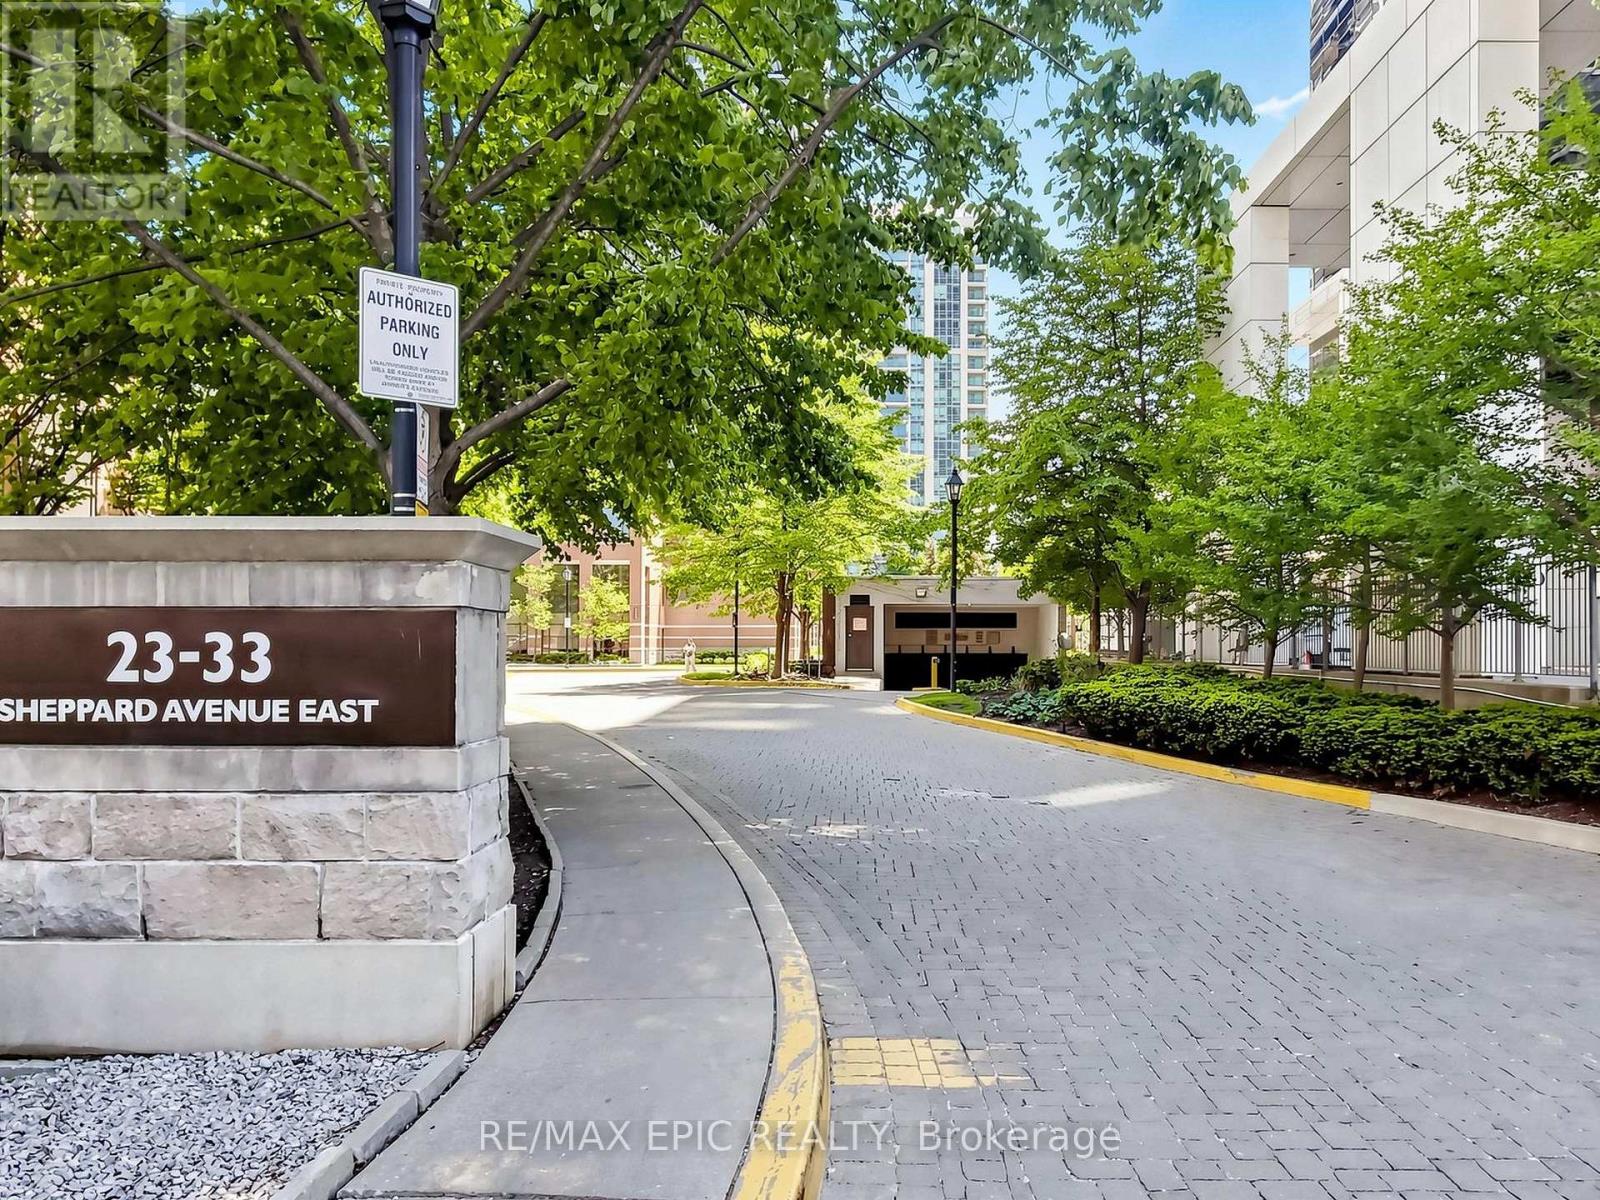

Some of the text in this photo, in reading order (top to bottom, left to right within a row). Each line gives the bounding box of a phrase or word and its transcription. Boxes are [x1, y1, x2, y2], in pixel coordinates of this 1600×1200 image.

[367, 290, 452, 318] AUTHORIZED
[380, 316, 440, 339] PARKING
[393, 342, 428, 360] ONLY
[106, 631, 272, 683] 23-33
[0, 698, 380, 723] SHEPPARD AVENUE EAST
